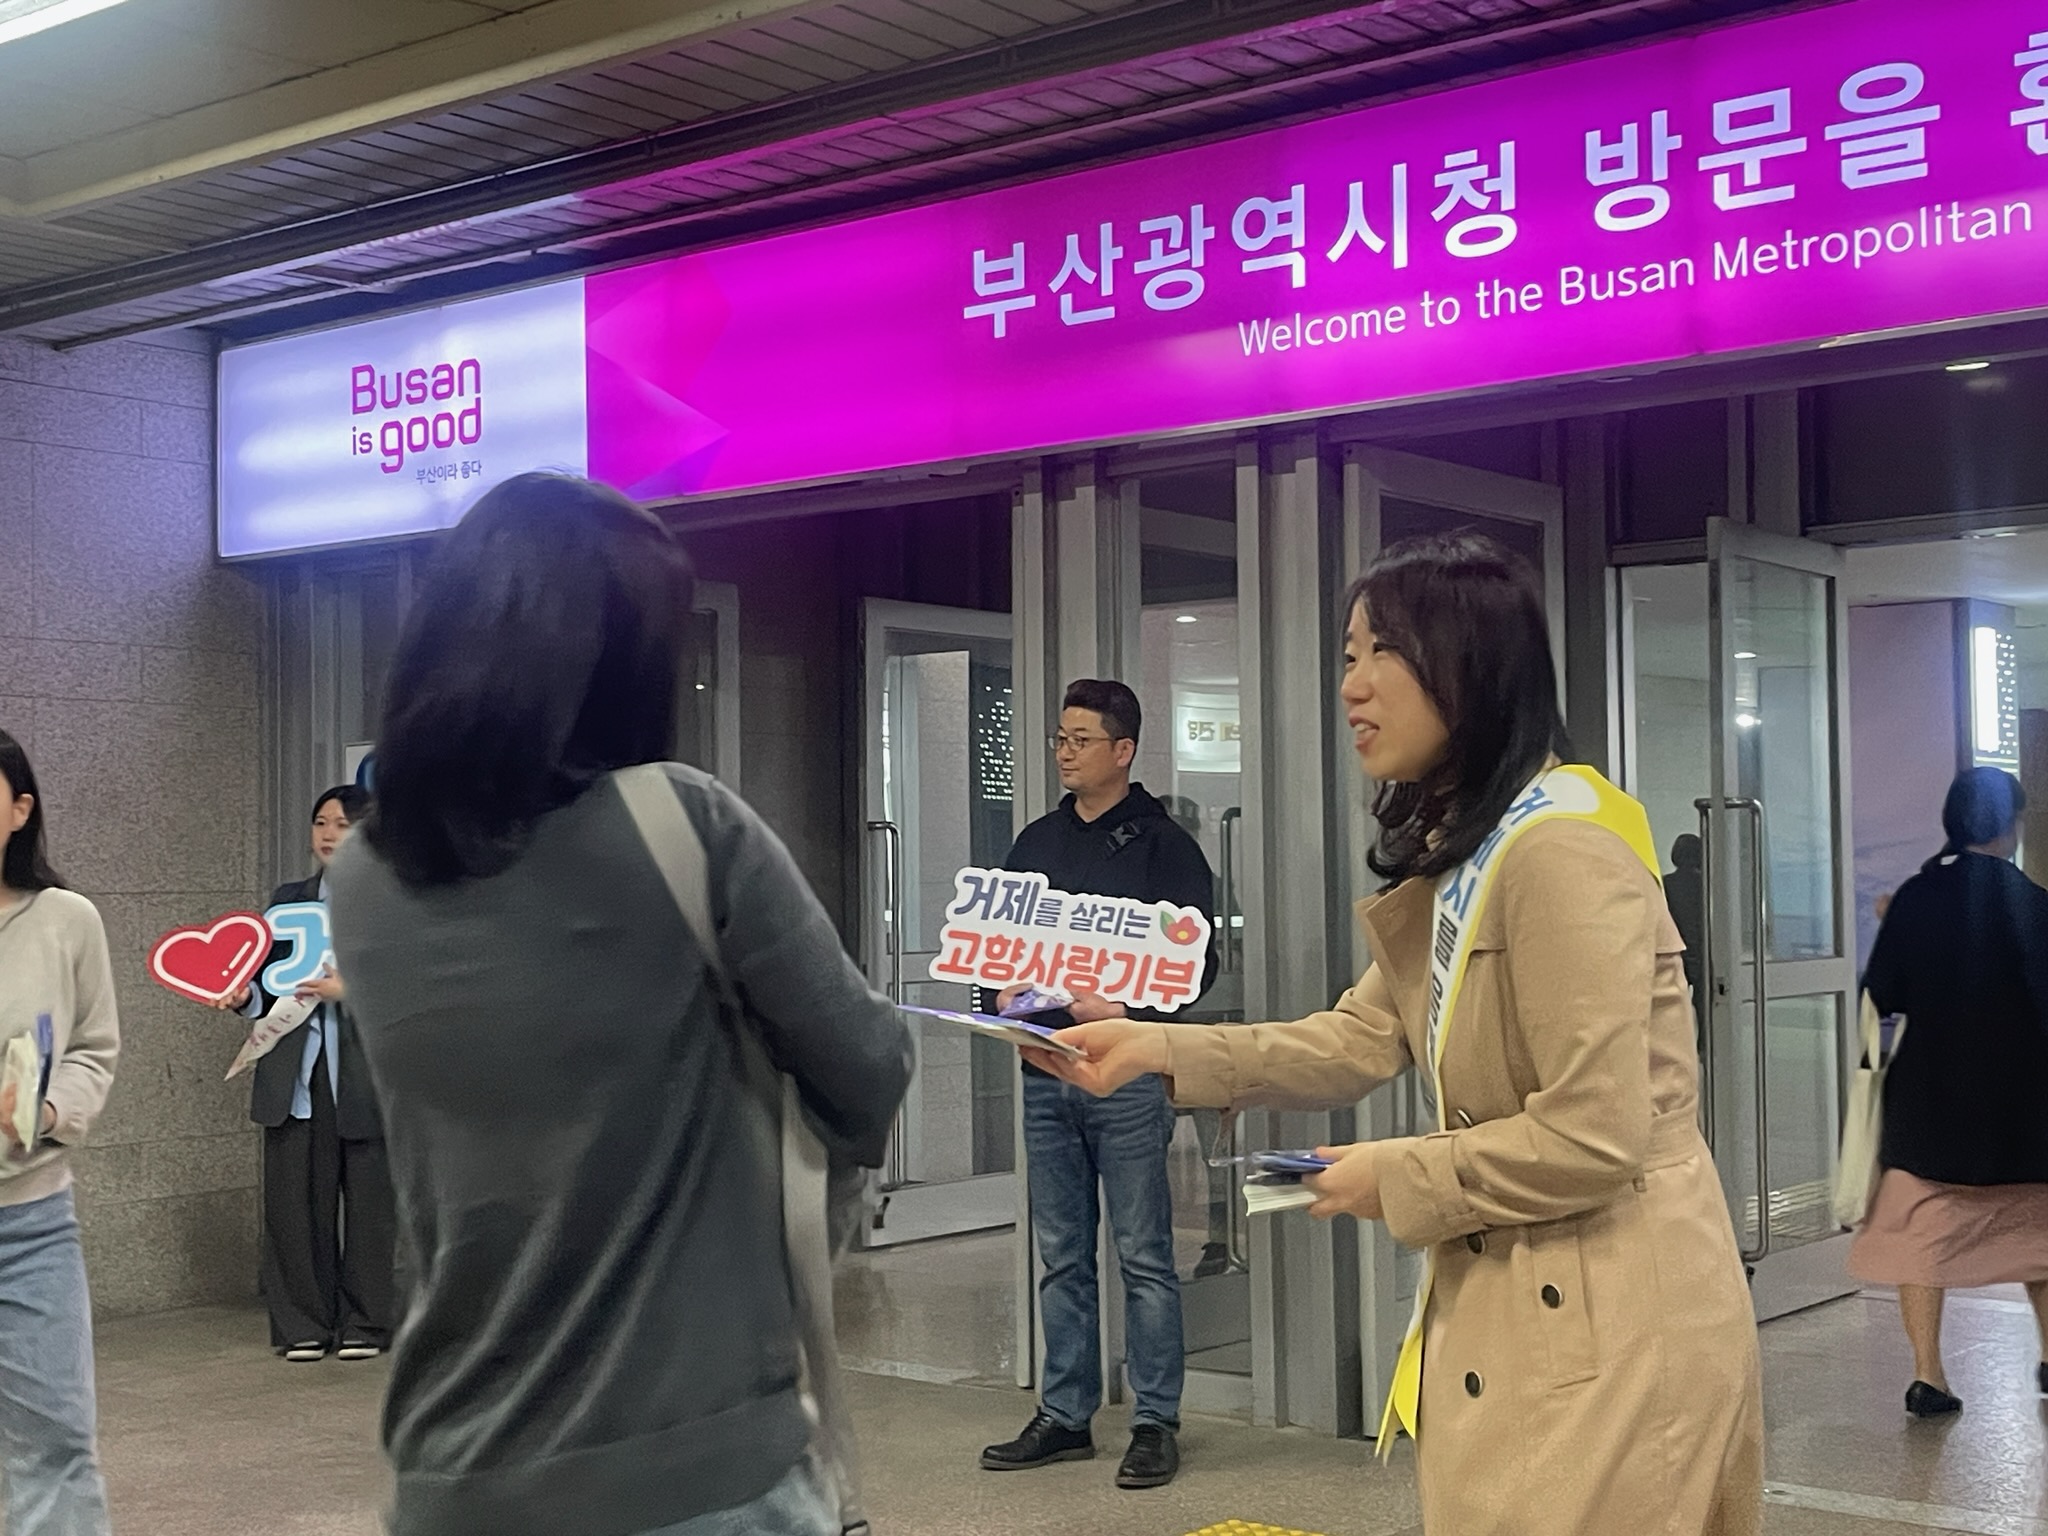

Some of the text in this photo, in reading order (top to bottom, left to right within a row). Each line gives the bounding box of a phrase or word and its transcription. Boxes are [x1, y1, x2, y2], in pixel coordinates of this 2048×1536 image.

[963, 138, 1519, 339] 부산광역시청
[1584, 61, 1941, 233] 방문을
[1238, 200, 2034, 357] Welcome to the Busan Metropolitan
[351, 358, 481, 415] Busan
[352, 396, 482, 474] is good
[415, 459, 483, 485] 부산이라 좋다
[953, 875, 1152, 939] 거제를 살리는
[936, 929, 1197, 1005] 고향사랑기부
